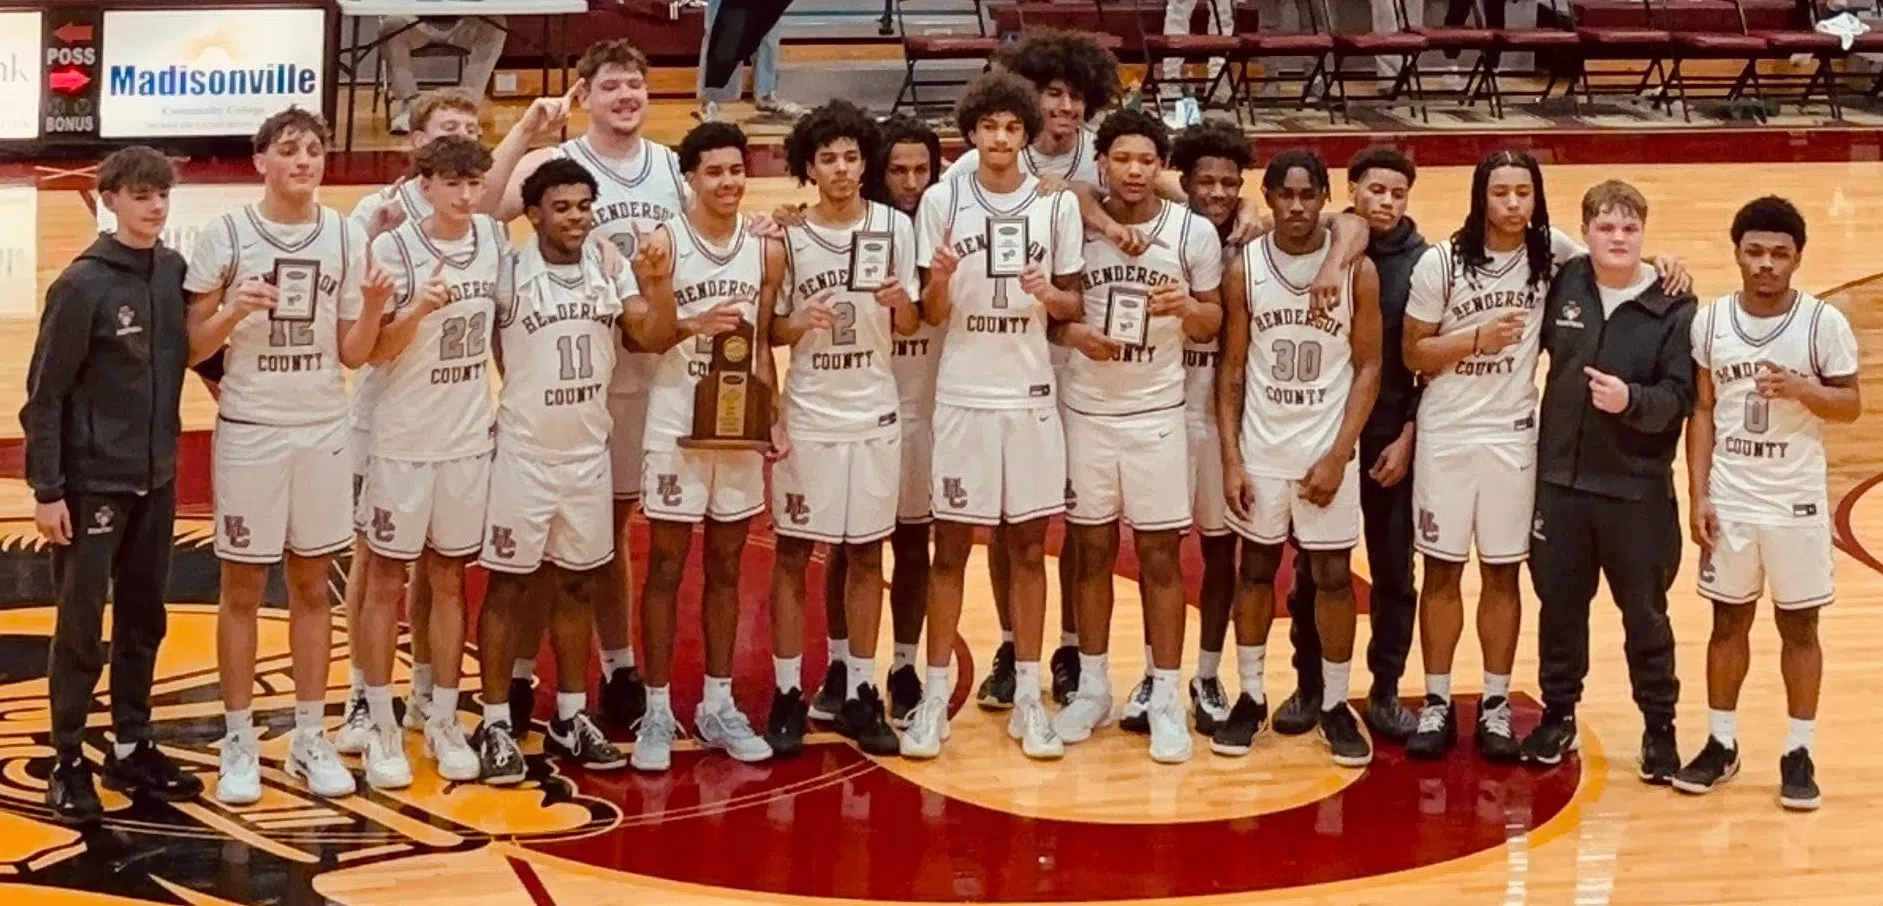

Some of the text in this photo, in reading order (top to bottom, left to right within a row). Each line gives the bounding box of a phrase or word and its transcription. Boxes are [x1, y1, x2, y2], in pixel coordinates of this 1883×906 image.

[47, 47, 96, 65] POSS
[110, 63, 316, 96] Madisonville
[46, 115, 94, 132] BONUS
[597, 202, 675, 224] ENDERSO
[1082, 265, 1180, 290] HENDERSO
[1453, 291, 1536, 320] HENDERSO
[831, 301, 857, 345] 2
[966, 315, 1030, 334] COUNTY
[440, 311, 487, 361] 22
[258, 353, 323, 371] COUNTY
[557, 334, 594, 380] 11
[812, 350, 874, 370] COUNTY
[1271, 338, 1322, 382] 30
[544, 384, 602, 406] COUNTY
[1266, 386, 1327, 405] COUNTY
[1743, 392, 1769, 434] 0
[1725, 437, 1788, 458] COUNTY
